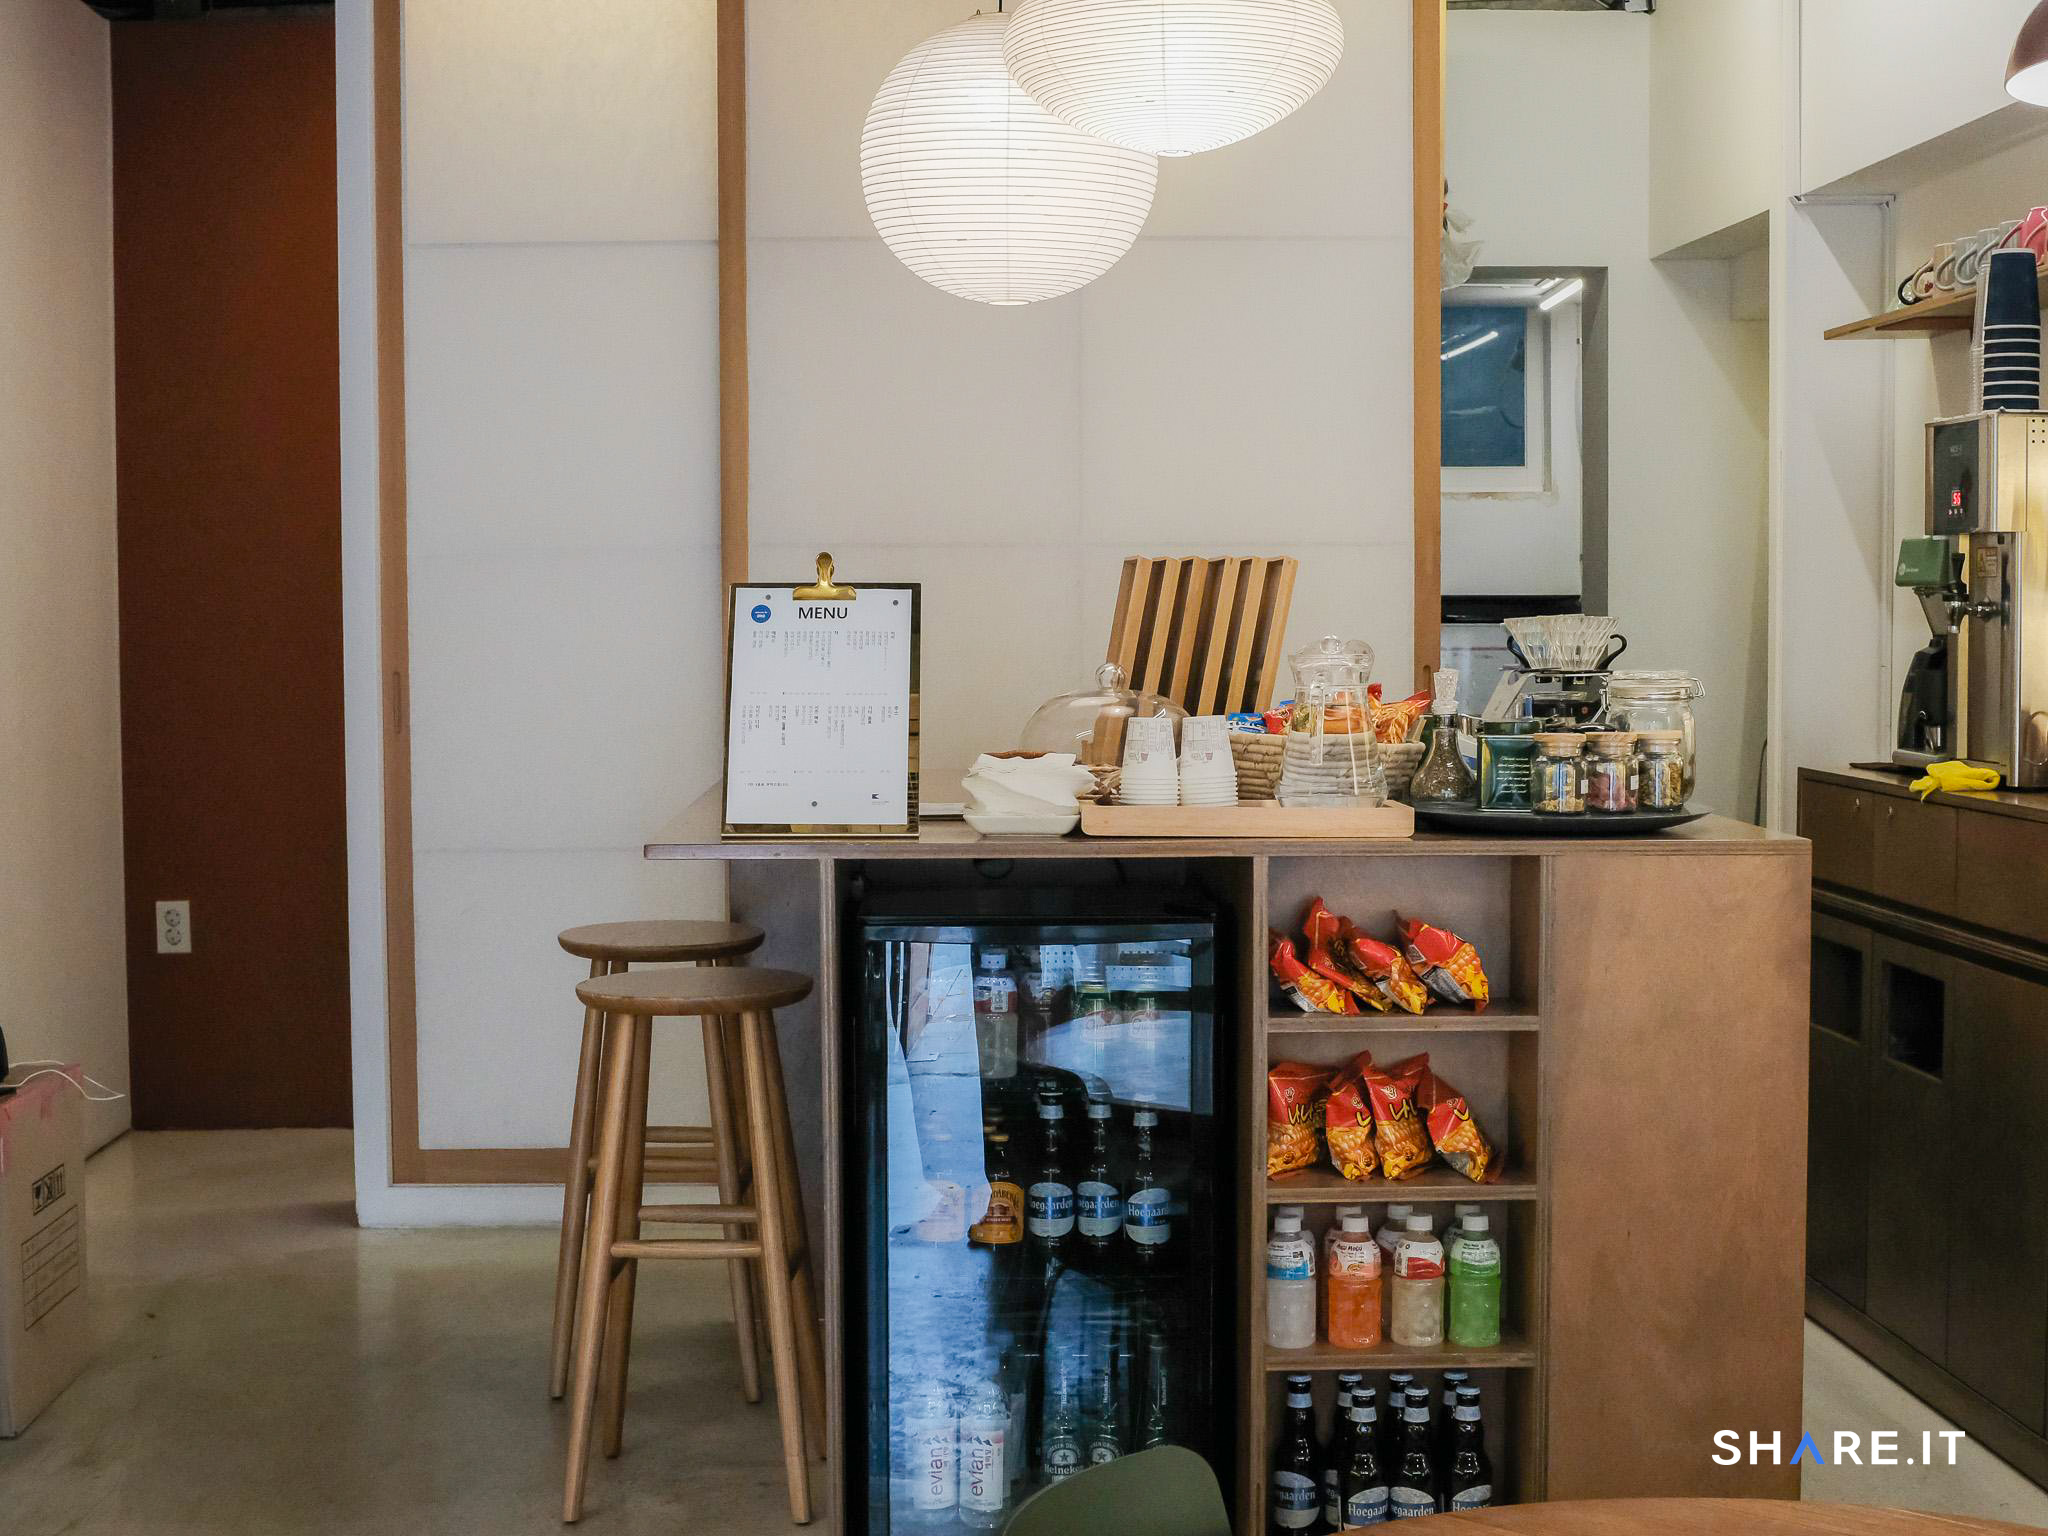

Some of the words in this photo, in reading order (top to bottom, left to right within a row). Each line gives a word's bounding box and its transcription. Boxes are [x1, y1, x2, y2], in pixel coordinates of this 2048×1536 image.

[798, 607, 848, 619] MENU
[928, 1447, 944, 1496] evian
[968, 1447, 985, 1497] evian
[1044, 1463, 1080, 1475] Heineke
